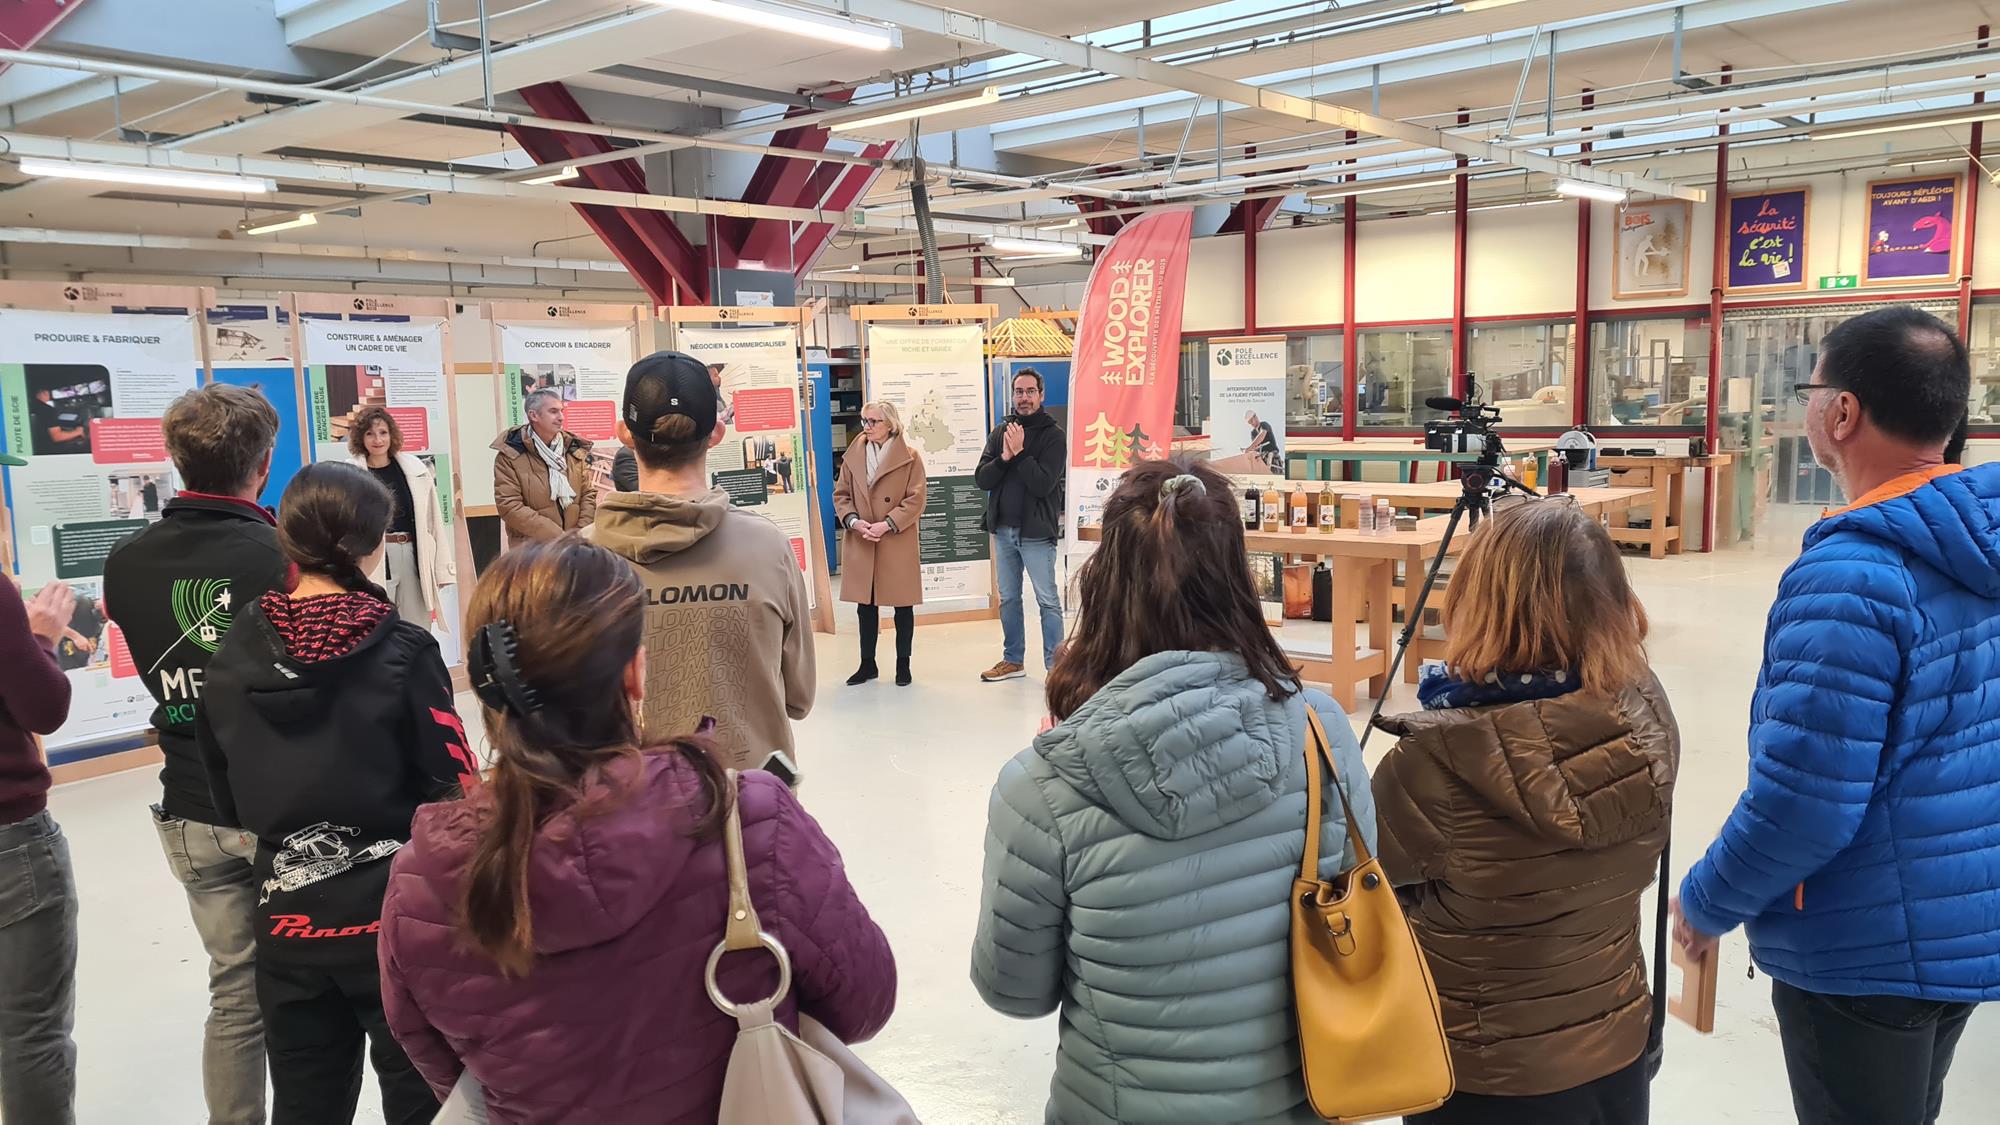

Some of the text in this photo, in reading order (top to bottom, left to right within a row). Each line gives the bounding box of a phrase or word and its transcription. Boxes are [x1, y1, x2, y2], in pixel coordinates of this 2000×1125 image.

[1871, 190, 1912, 199] TOUJOURS
[1883, 198, 1908, 206] AVANT
[1910, 196, 1936, 204] D'AGIR
[1737, 216, 1797, 234] sécurité
[1102, 277, 1129, 366] WOOD
[1125, 258, 1155, 385] EXPLORER
[34, 333, 161, 345] PRODUIRE & FABRIQUER
[327, 333, 375, 342] CONSTRUIRE
[383, 333, 423, 342] AMÉNAGER
[524, 341, 566, 349] CONCEVOIR
[690, 342, 723, 350] NÉGOCIER
[731, 341, 786, 349] COMMERCIALISER
[671, 398, 679, 406] S
[13, 414, 21, 425] DE
[15, 426, 23, 454] PILOTE
[646, 583, 749, 605] LOMON
[647, 606, 750, 635] LOMON
[160, 667, 203, 701] MF
[270, 914, 381, 938] Prinot
